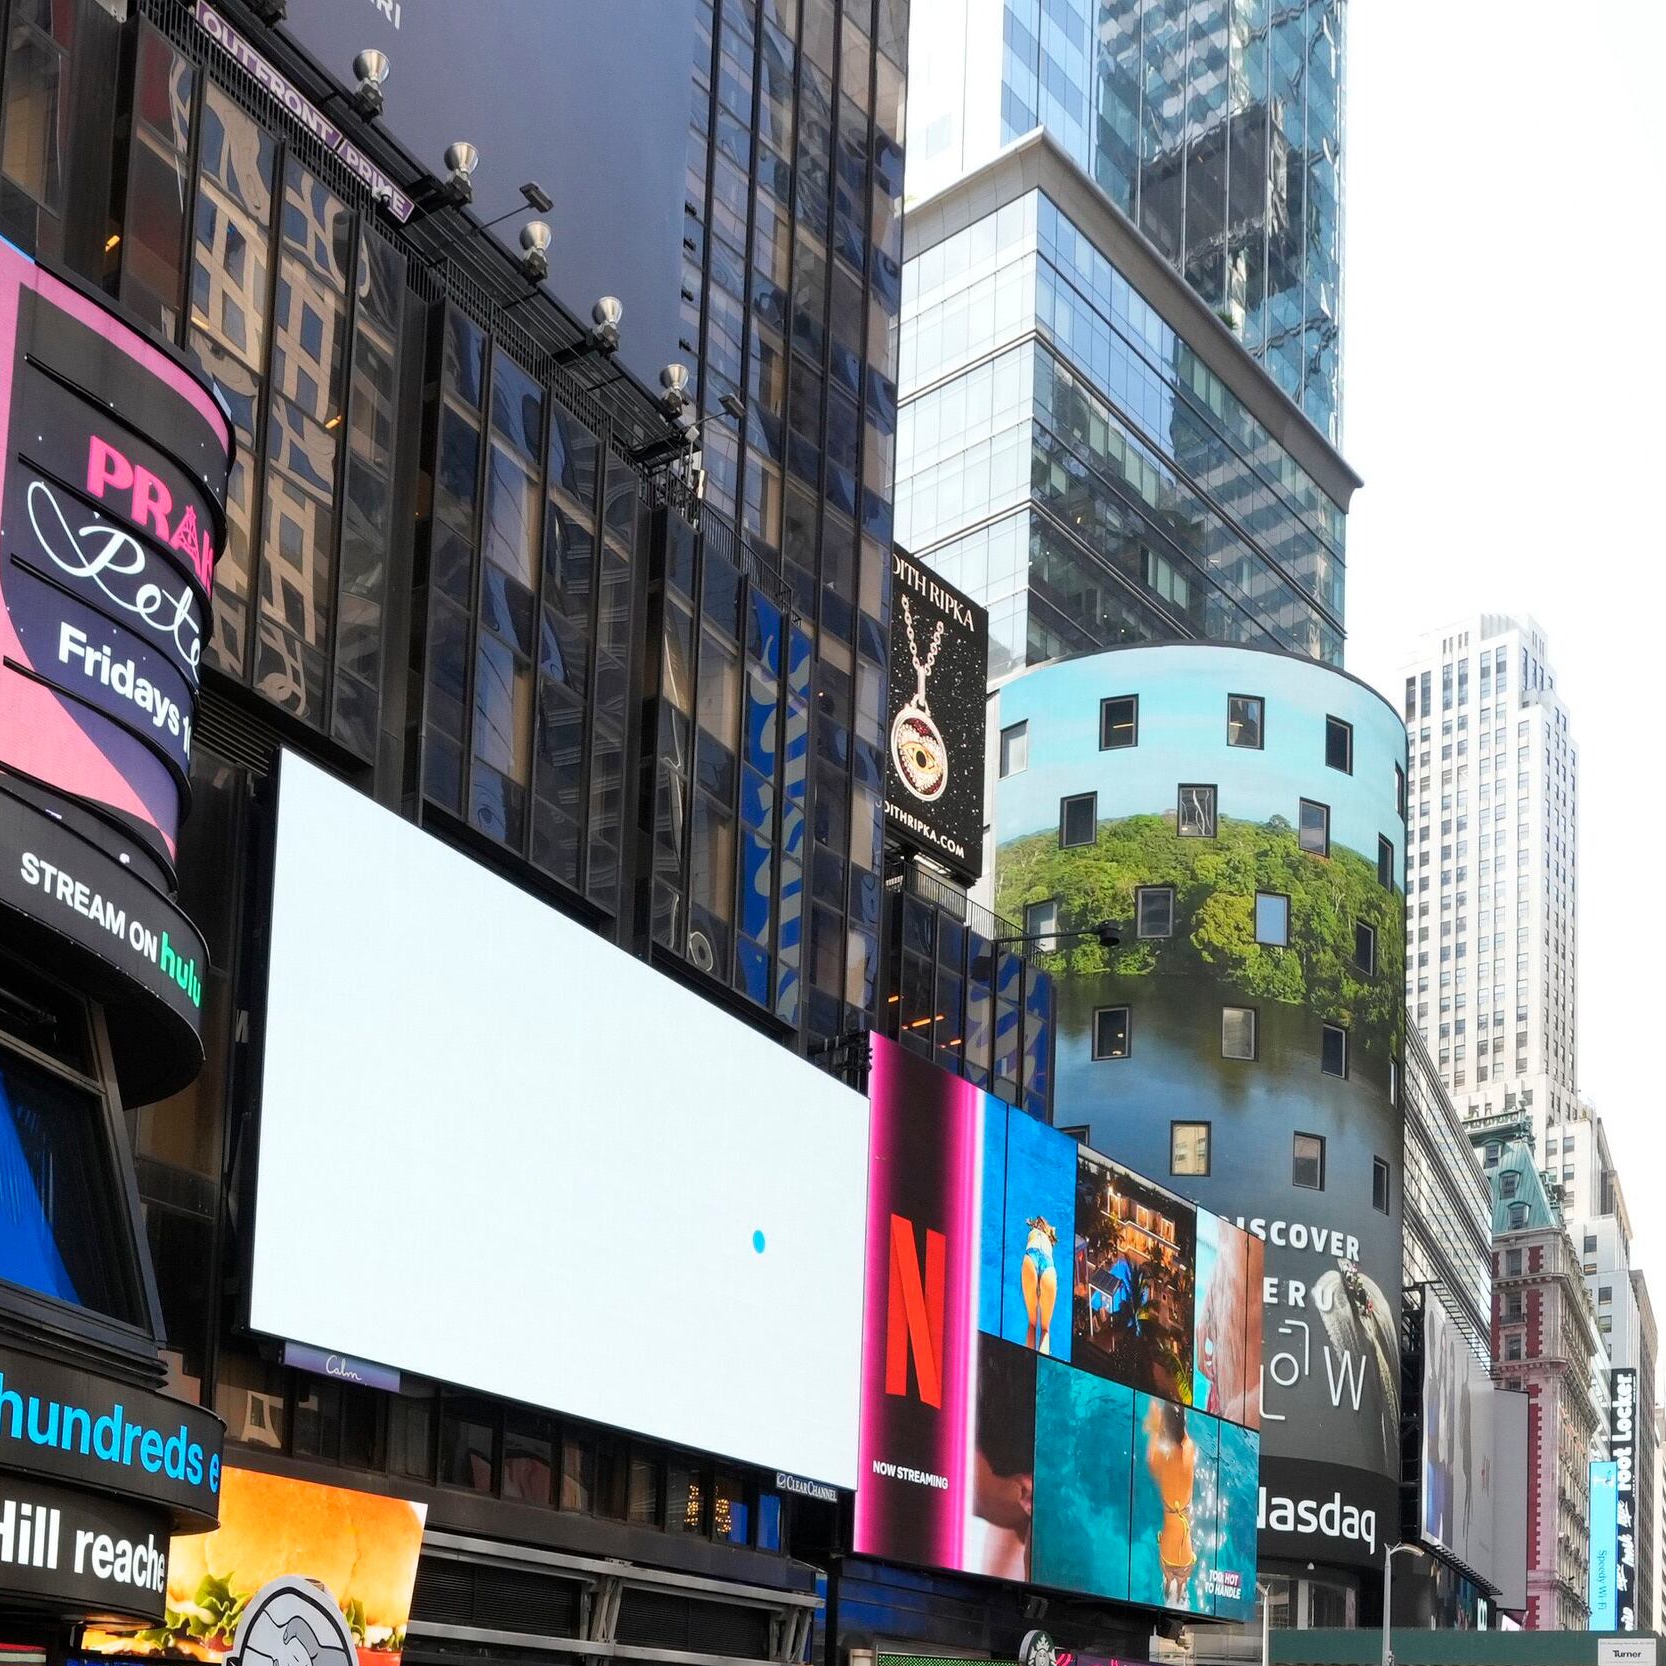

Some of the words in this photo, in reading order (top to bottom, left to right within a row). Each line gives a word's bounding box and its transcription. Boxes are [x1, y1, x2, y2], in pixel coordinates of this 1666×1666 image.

[930, 584, 974, 632] RIPKA
[58, 621, 179, 728] Fridays
[20, 851, 125, 940] STREAM
[129, 921, 158, 963] ON
[160, 931, 201, 1007] hulu
[873, 1460, 894, 1477] NOW
[896, 1465, 948, 1490] STREAMING
[74, 1528, 166, 1595] reache
[1597, 1550, 1607, 1585] Speedy
[1217, 1583, 1241, 1600] HANDLE
